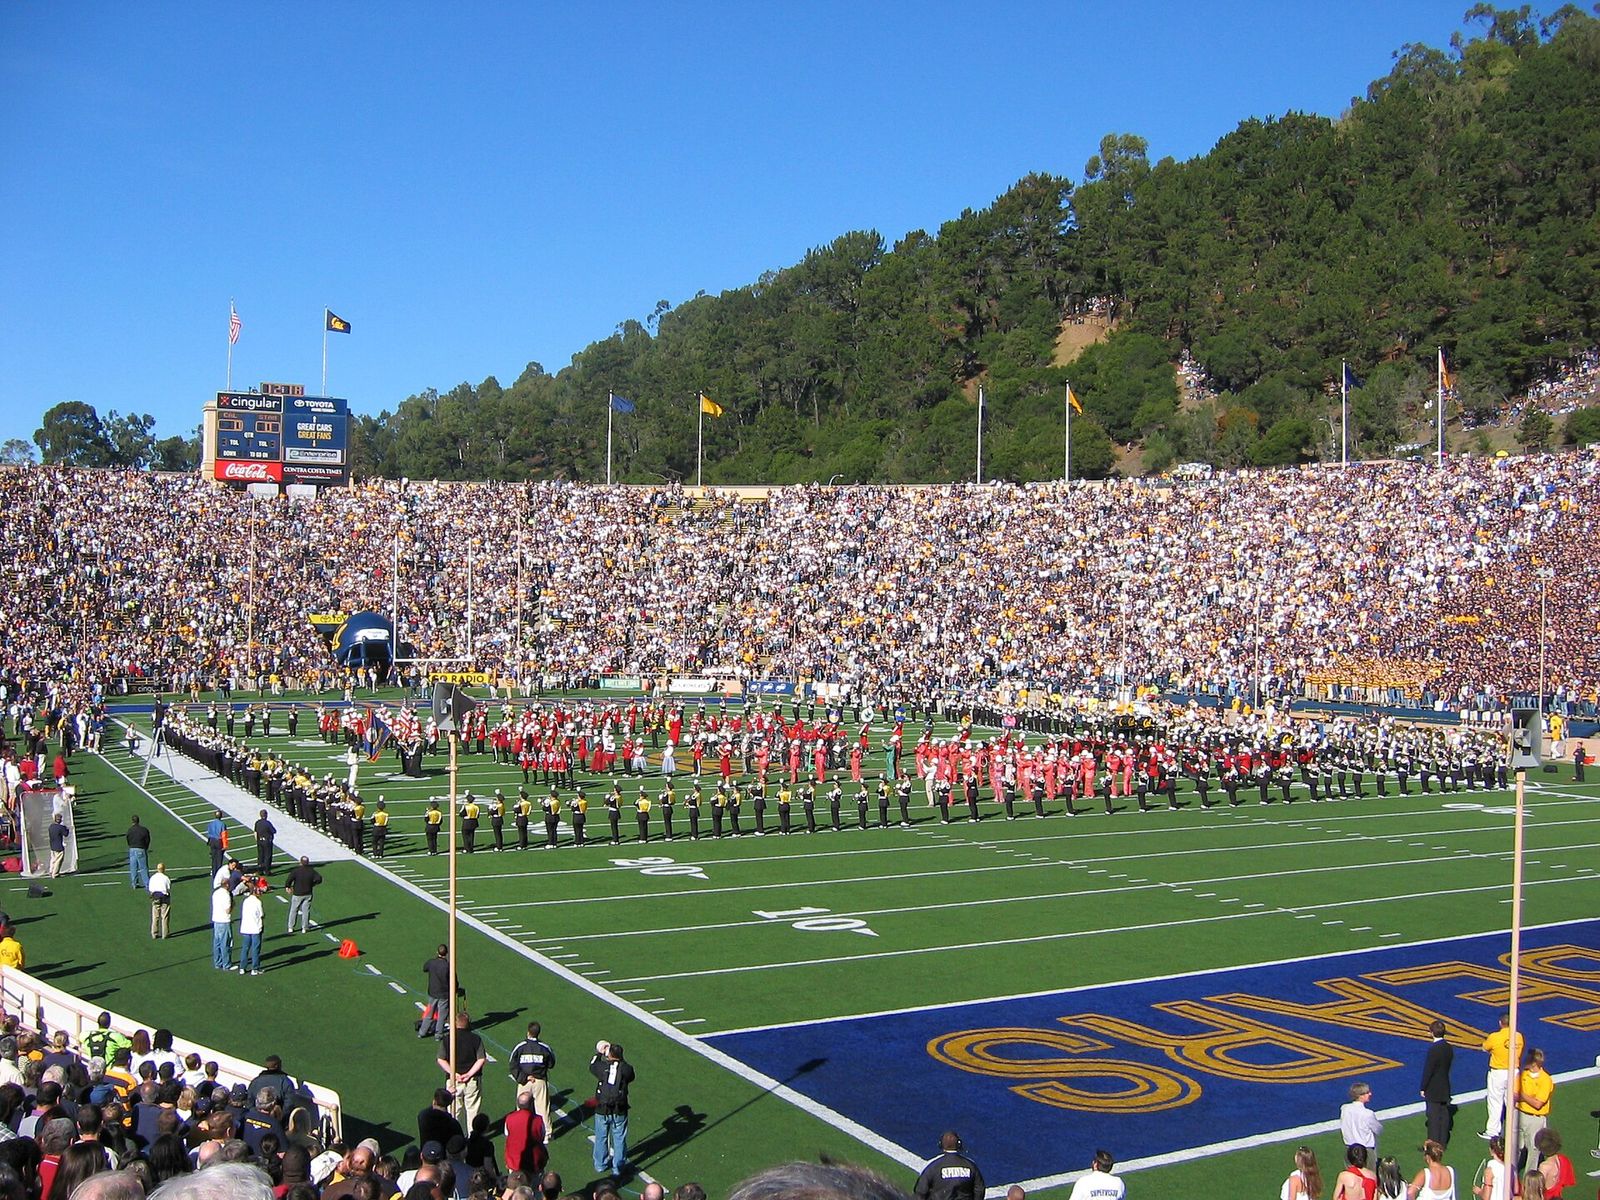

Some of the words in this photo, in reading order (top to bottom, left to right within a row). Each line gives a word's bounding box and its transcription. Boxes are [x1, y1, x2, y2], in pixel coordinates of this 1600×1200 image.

[231, 396, 278, 410] cingular
[305, 400, 334, 408] TOYOTA
[297, 423, 316, 431] GREAT
[298, 431, 316, 439] GREAT
[451, 674, 485, 684] RADIO
